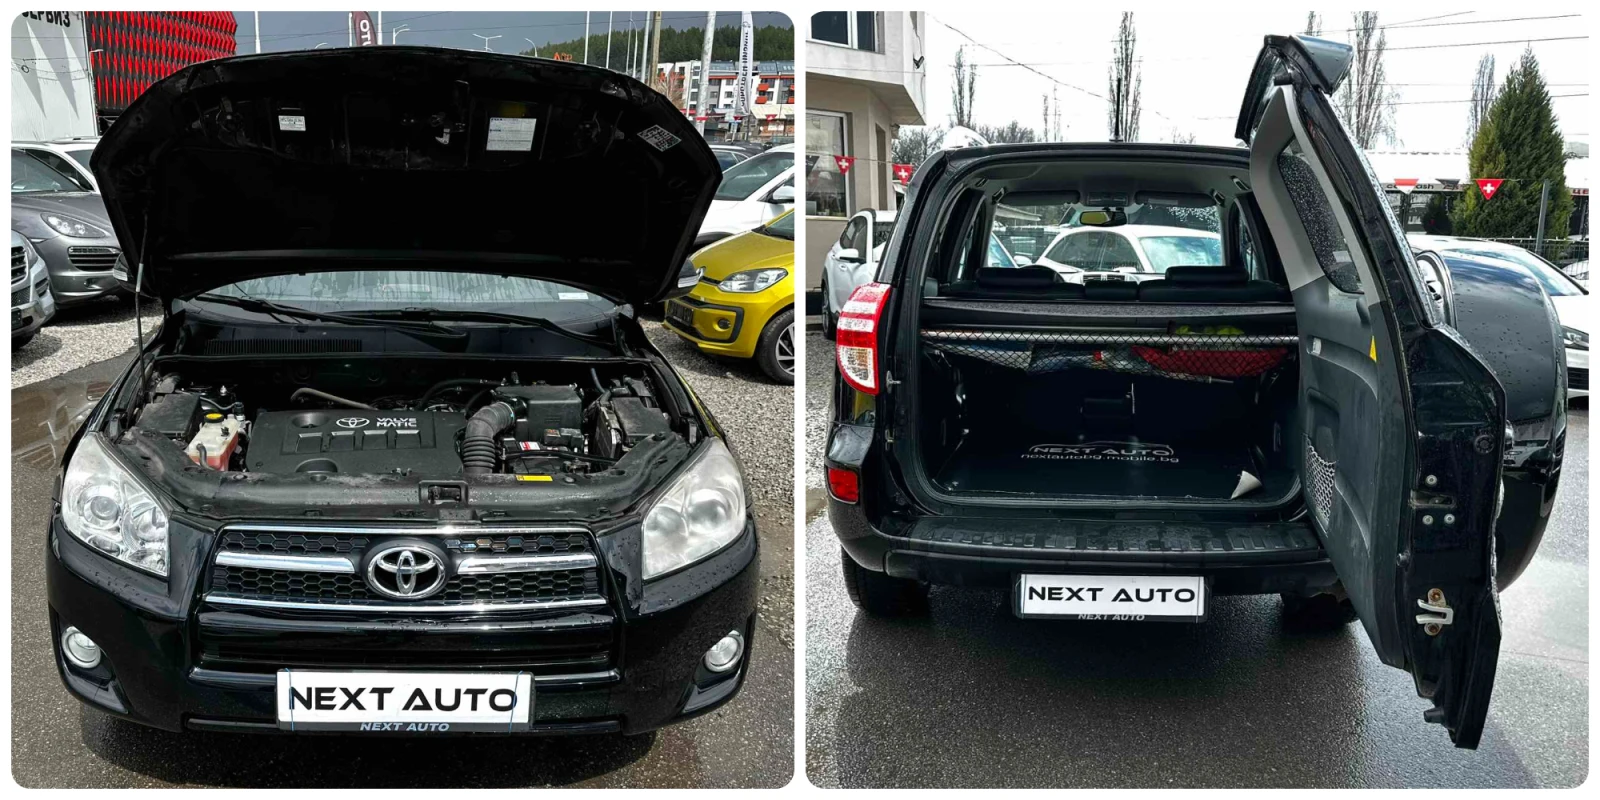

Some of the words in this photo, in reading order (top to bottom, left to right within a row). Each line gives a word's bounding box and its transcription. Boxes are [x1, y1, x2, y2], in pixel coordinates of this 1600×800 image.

[1033, 446, 1097, 454] NEXT
[1099, 447, 1171, 456] AUTO
[1020, 453, 1180, 464] nextautobg.mobile.bg
[1028, 586, 1104, 602] NEXT
[1111, 587, 1196, 603] AUTO
[1077, 613, 1111, 621] NEXT
[1112, 614, 1146, 622] AUTO
[289, 686, 395, 711] NEXT
[401, 687, 518, 712] AUTO
[359, 721, 404, 732] NEXT
[405, 722, 450, 732] AUTO
